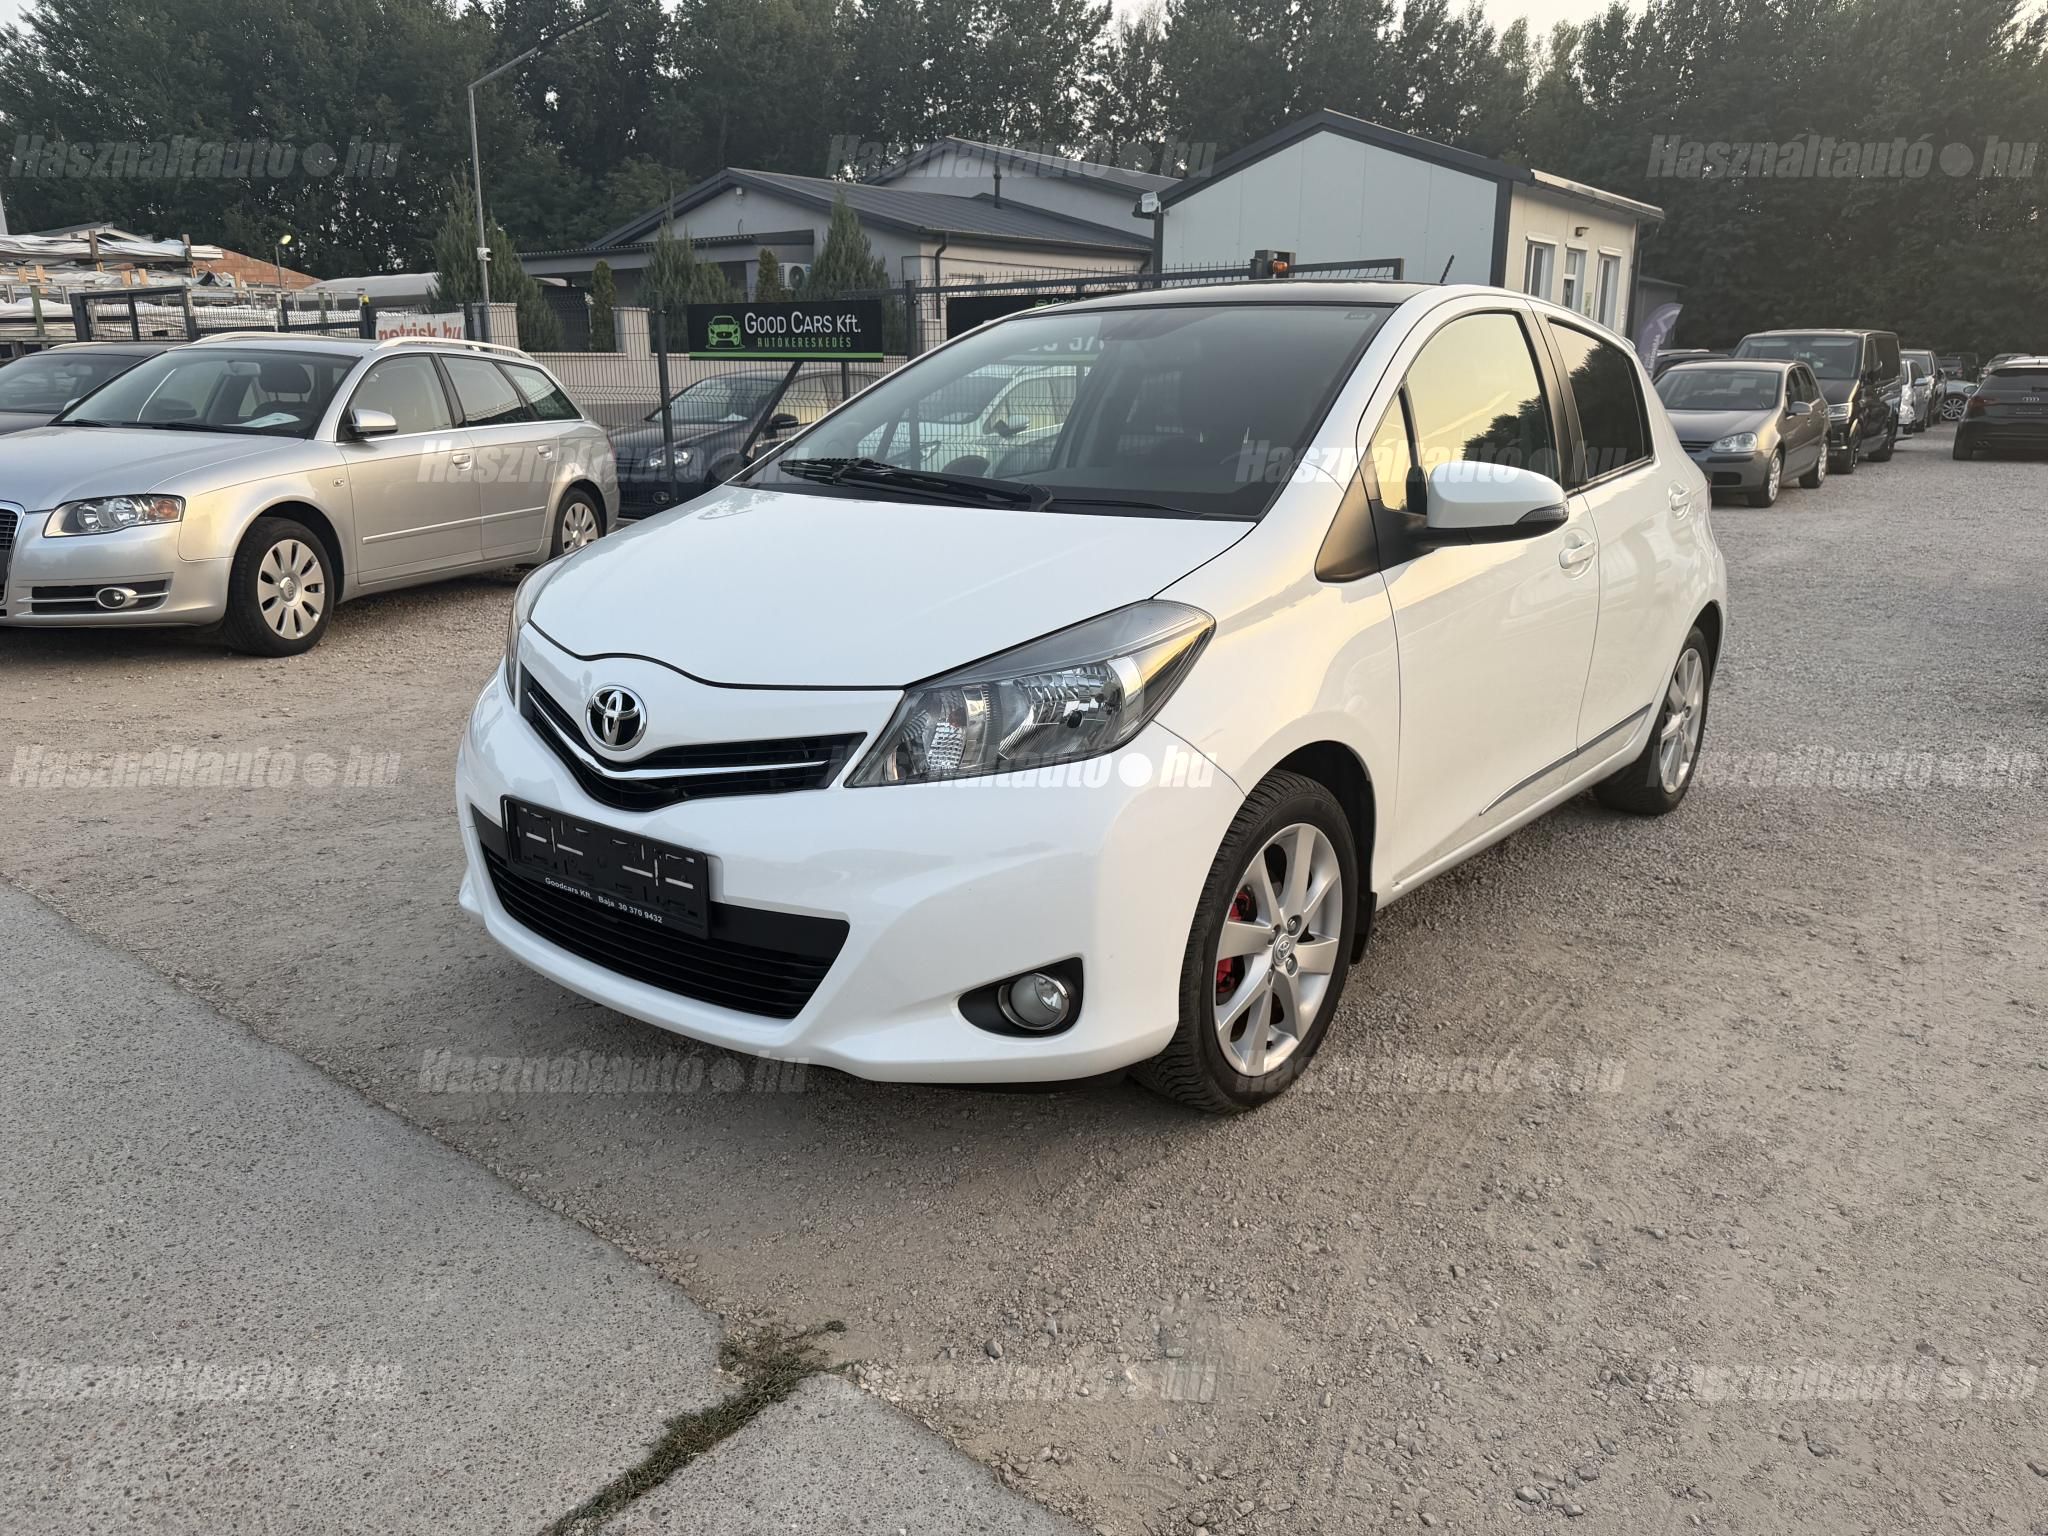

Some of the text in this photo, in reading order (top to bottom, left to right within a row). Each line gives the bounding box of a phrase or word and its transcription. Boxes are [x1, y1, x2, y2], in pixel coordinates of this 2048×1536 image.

[744, 311, 862, 335] GOOD CARS Kft.
[757, 335, 852, 349] AUTÓKERESKEDÉS
[545, 877, 579, 895] Goodcars
[598, 895, 615, 908] Baja
[618, 902, 628, 911] 30
[629, 906, 643, 917] 370
[644, 911, 663, 924] 9432
